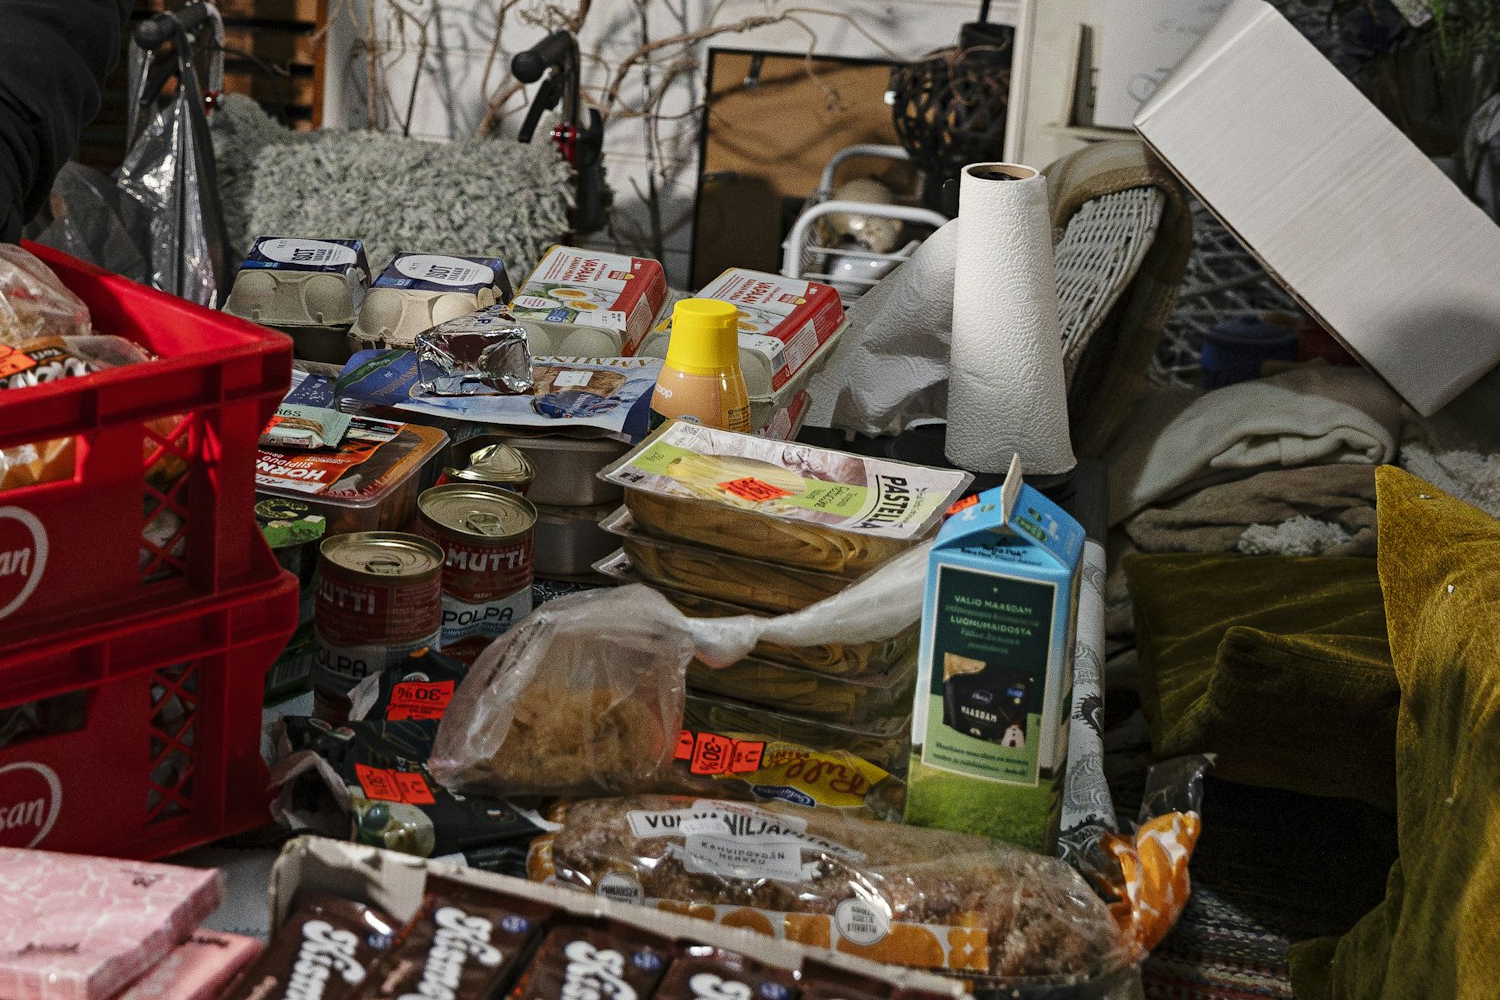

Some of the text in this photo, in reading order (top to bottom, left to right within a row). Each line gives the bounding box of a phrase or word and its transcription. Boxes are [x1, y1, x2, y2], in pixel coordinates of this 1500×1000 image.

[256, 459, 327, 481] HORN
[852, 475, 910, 529] PASTELLA
[446, 548, 525, 572] MUTTI
[954, 595, 982, 606] VALIO
[442, 607, 514, 627] POLPA
[397, 686, 449, 701] -30%
[698, 736, 722, 771] -30%
